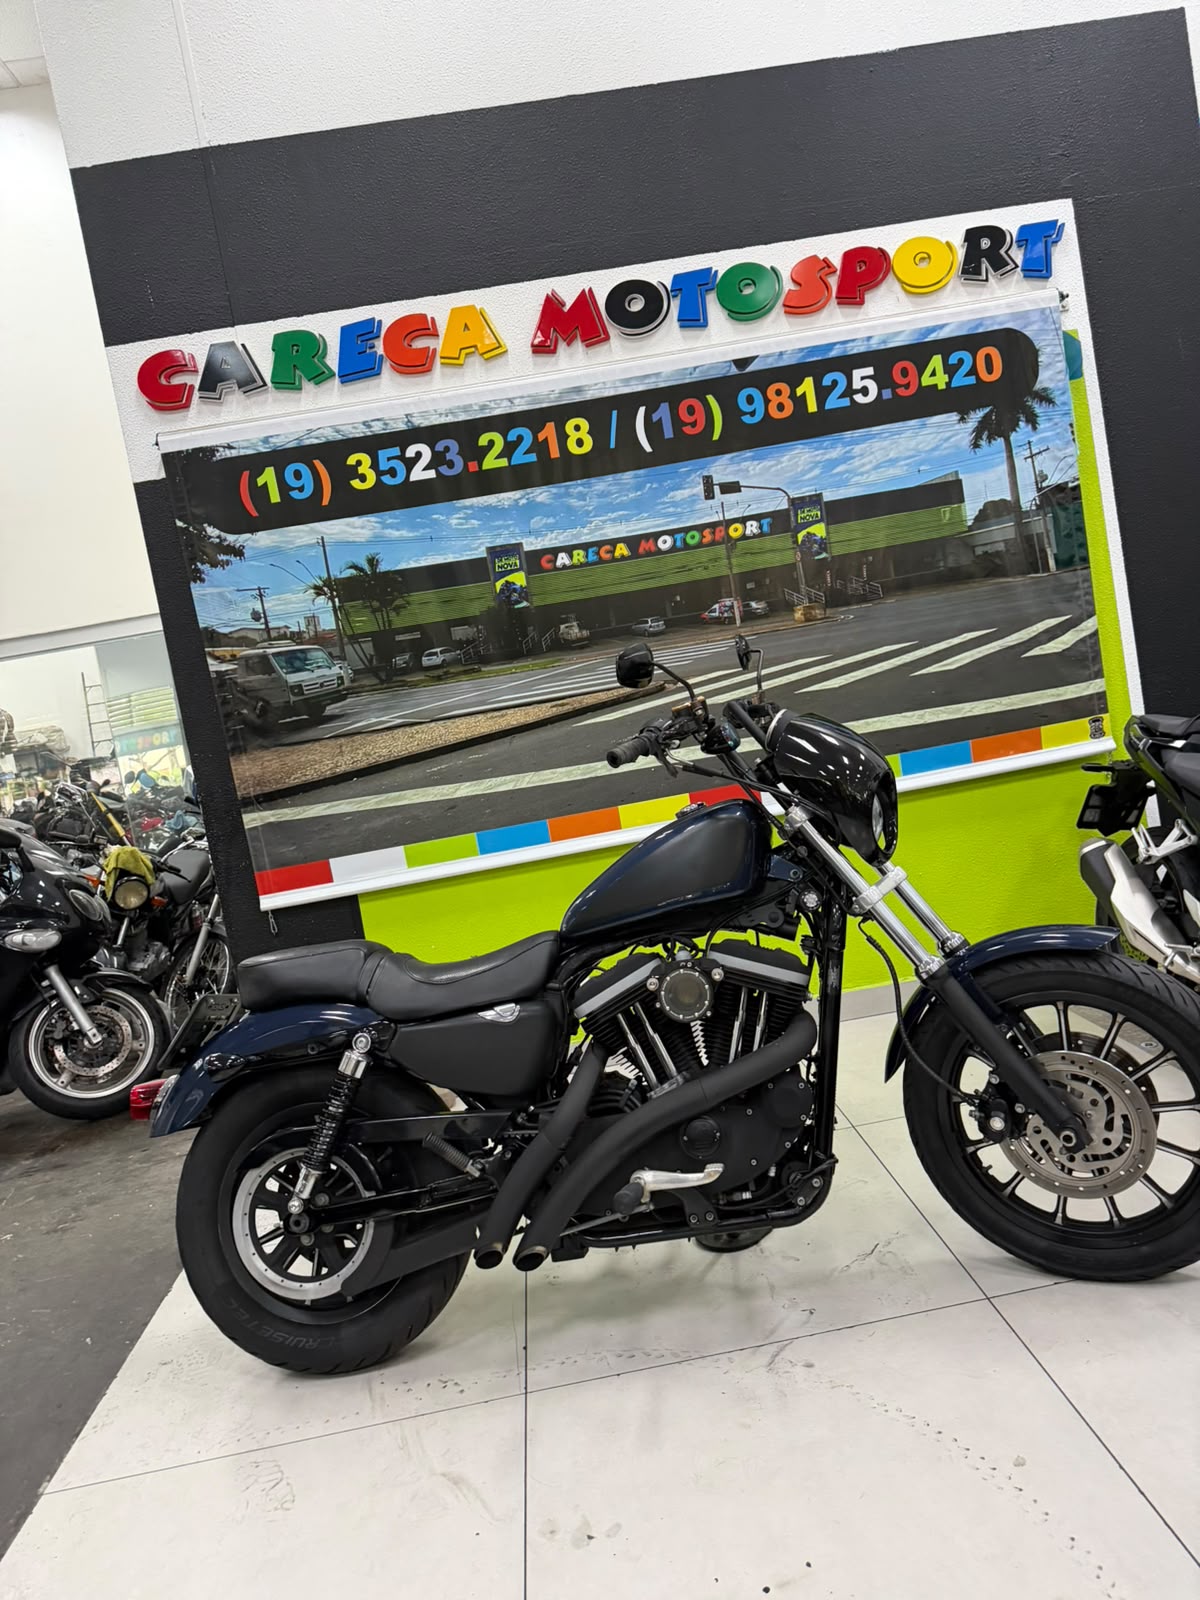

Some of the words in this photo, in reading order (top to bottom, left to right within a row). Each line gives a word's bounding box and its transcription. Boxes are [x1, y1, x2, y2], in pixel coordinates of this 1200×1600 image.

[137, 304, 507, 411] CARECA
[531, 219, 1064, 354] MOTOSPORT
[240, 457, 332, 517] (19)
[347, 417, 592, 490] 3523.2218
[609, 409, 620, 449] /
[635, 392, 724, 453] (19)
[738, 345, 1003, 424] 98125.9420
[497, 560, 518, 571] NOVA
[540, 542, 631, 570] CARECA
[637, 517, 773, 554] MOTOSPORT
